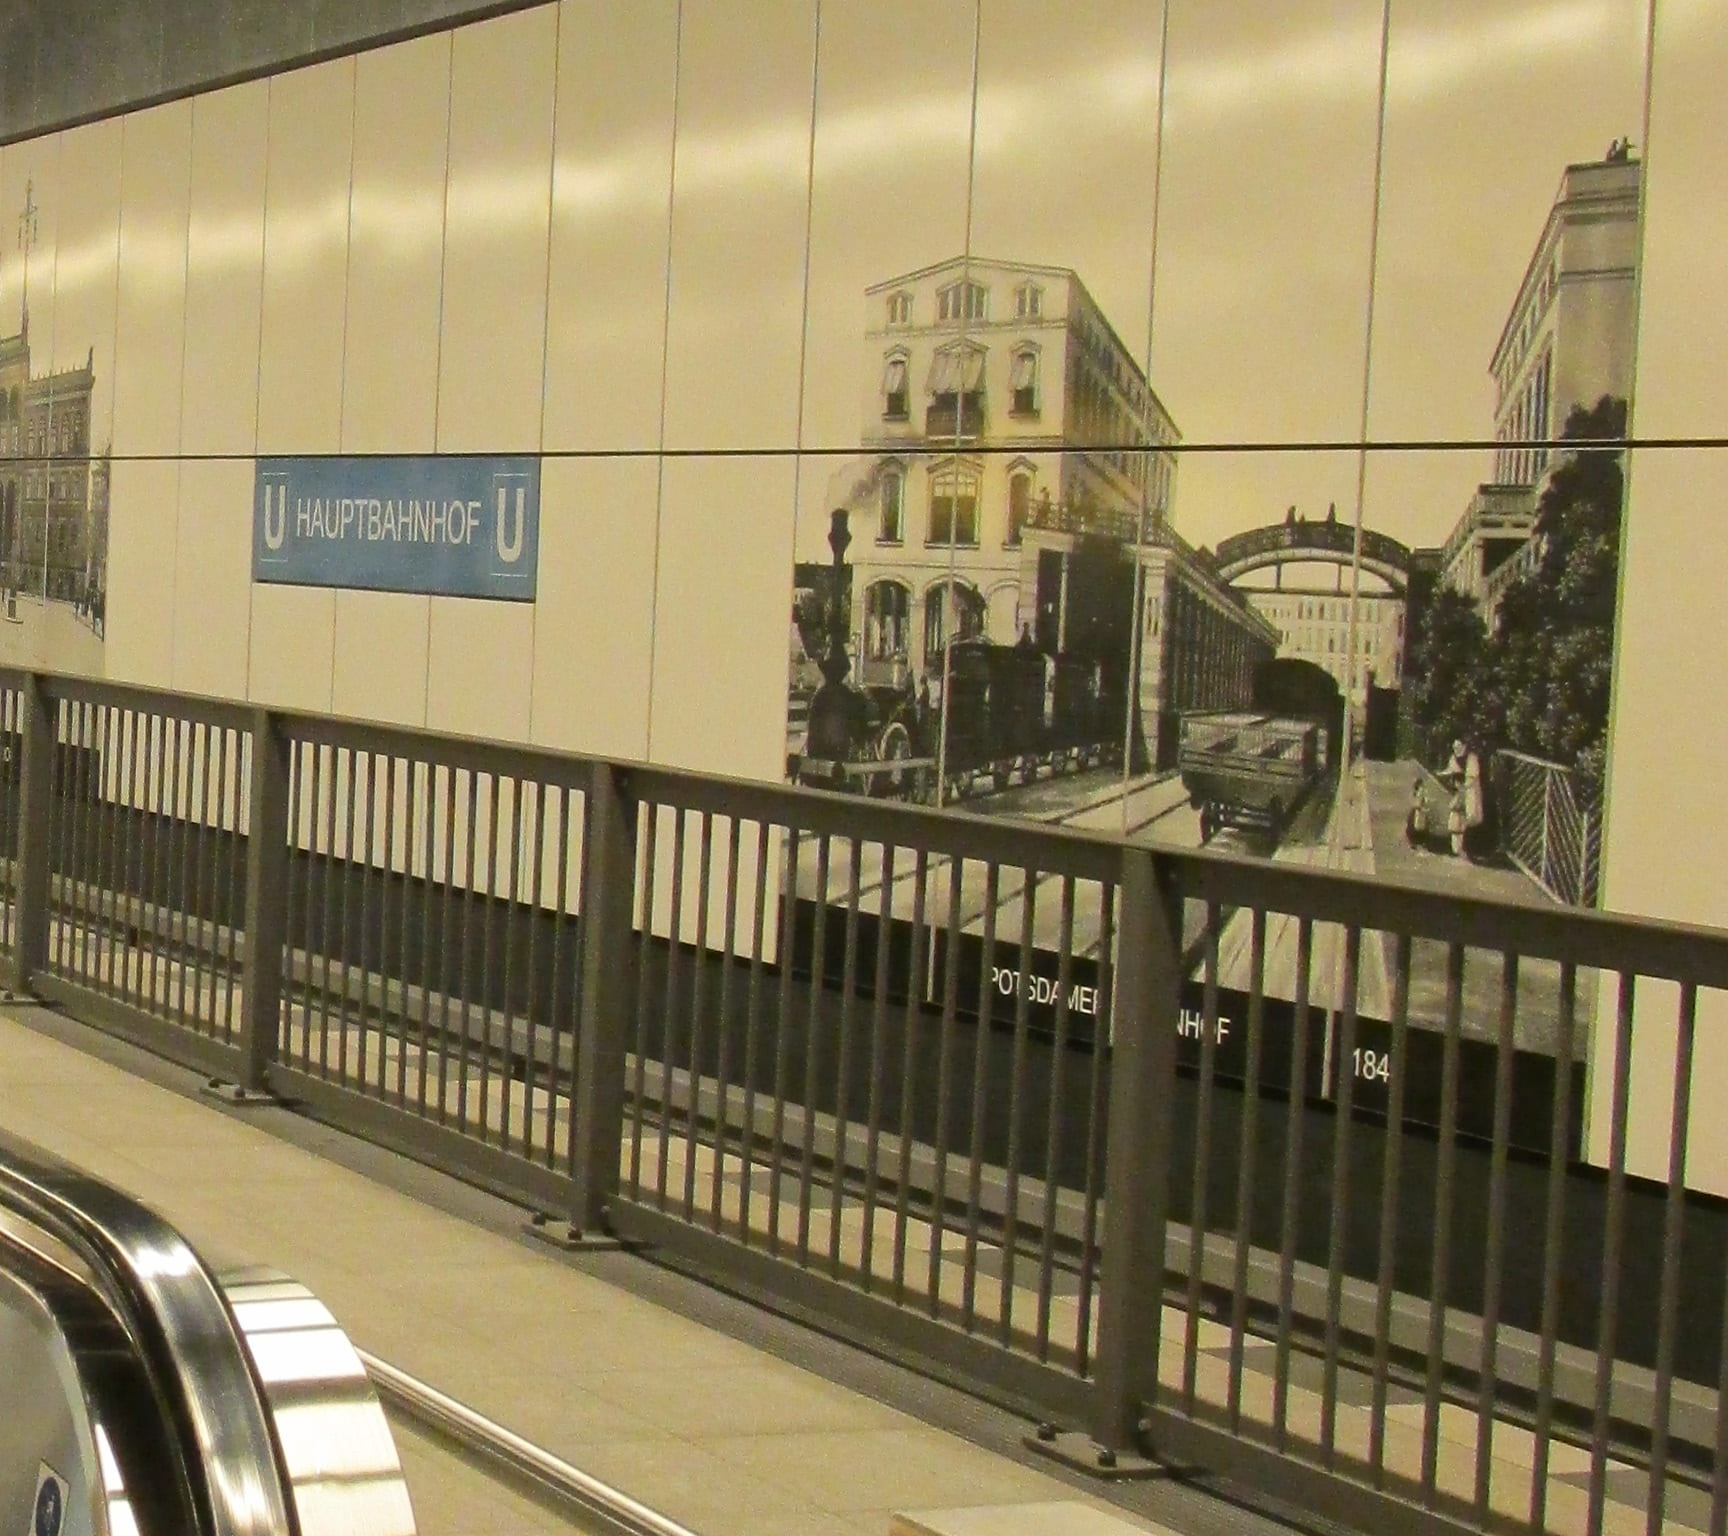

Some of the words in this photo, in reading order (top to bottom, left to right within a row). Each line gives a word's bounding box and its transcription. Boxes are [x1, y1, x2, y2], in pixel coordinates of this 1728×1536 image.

[264, 484, 286, 550] U
[296, 498, 482, 545] HAUPTBAHNHOF
[496, 487, 525, 563] U
[1353, 1048, 1390, 1083] 184
